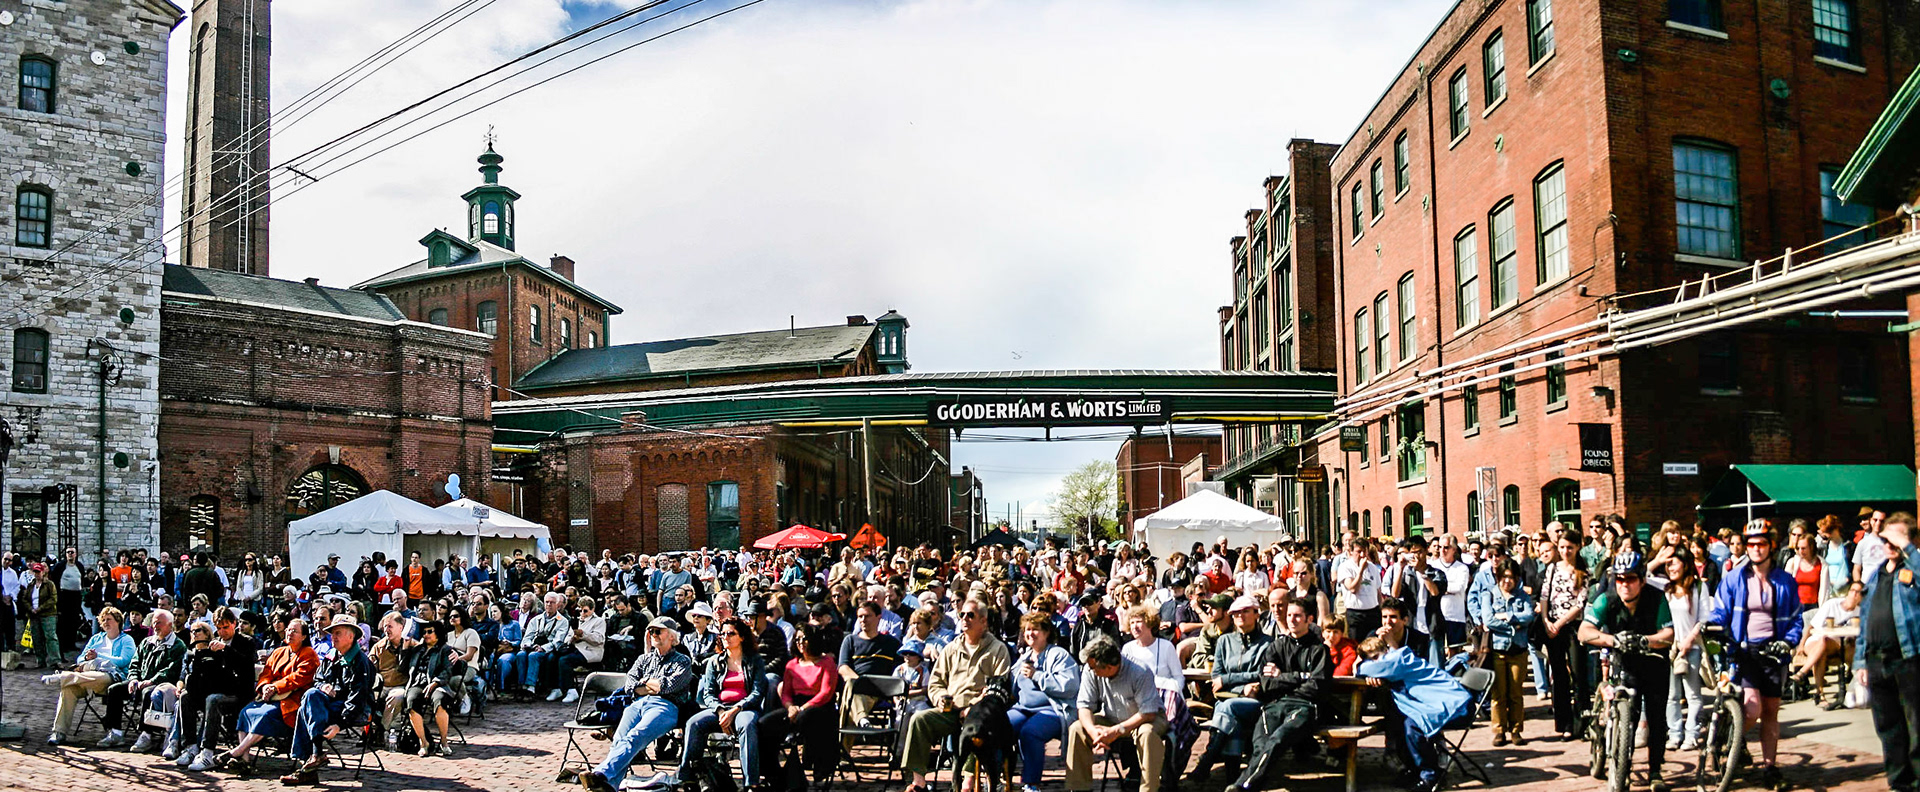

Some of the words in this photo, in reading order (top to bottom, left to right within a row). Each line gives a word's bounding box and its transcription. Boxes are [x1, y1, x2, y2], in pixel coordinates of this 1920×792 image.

[937, 402, 1045, 420] GOODERHAM
[1050, 402, 1065, 418] &
[1066, 400, 1127, 418] WORTS
[1584, 450, 1610, 458] FOUND
[1583, 459, 1611, 467] OBJECTS
